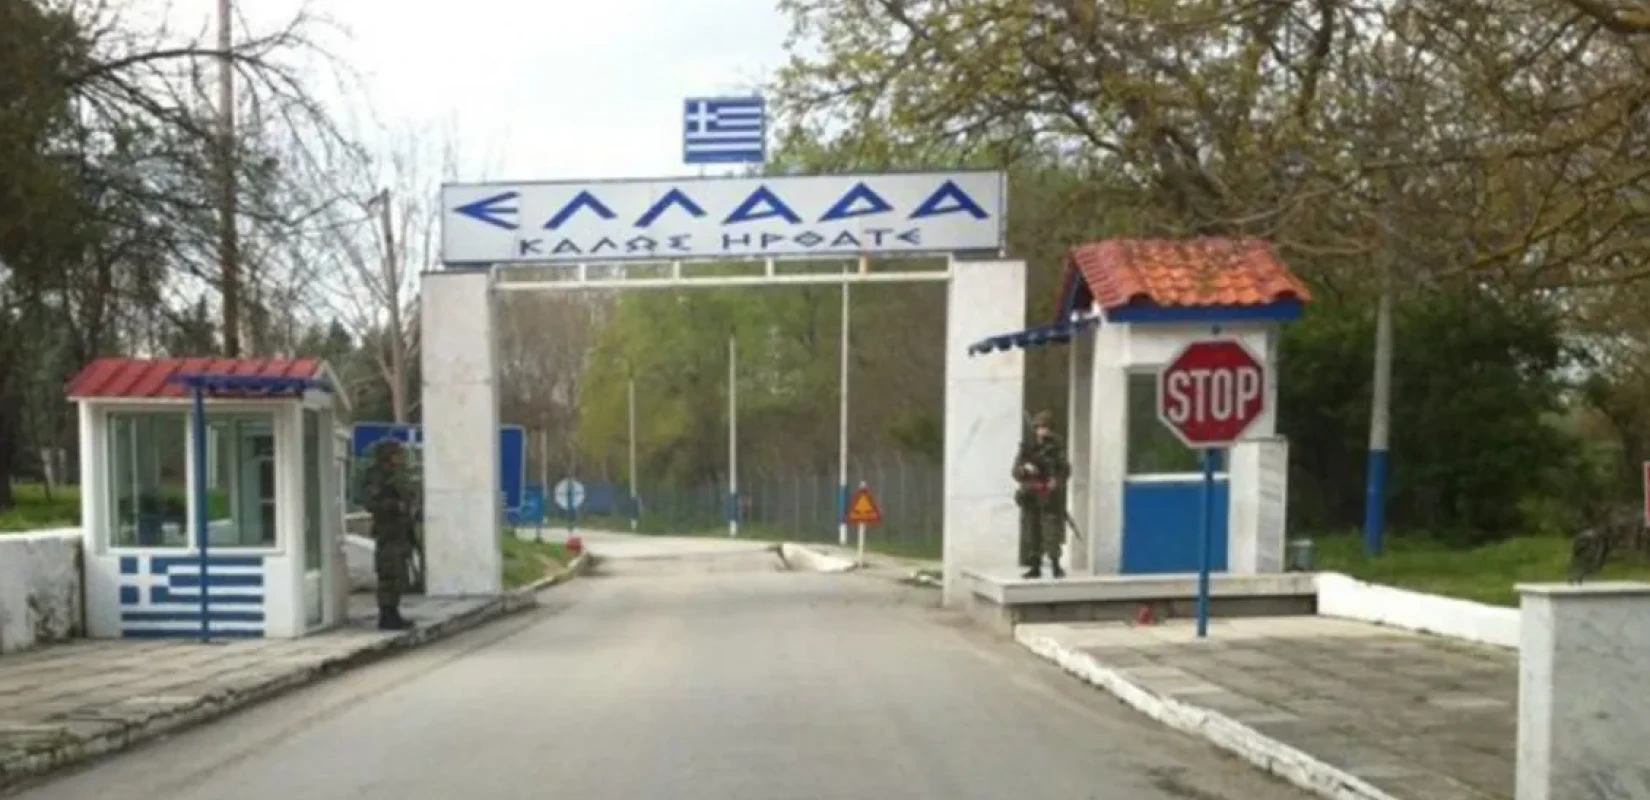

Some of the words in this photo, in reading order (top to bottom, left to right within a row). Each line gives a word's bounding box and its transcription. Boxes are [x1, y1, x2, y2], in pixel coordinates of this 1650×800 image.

[453, 179, 990, 230] ΕΛΛΑΔΑ
[519, 234, 693, 255] ΚΑΛΩΣ
[722, 227, 922, 250] ΗΡΘΑΤΕ
[1167, 366, 1260, 423] STOP
